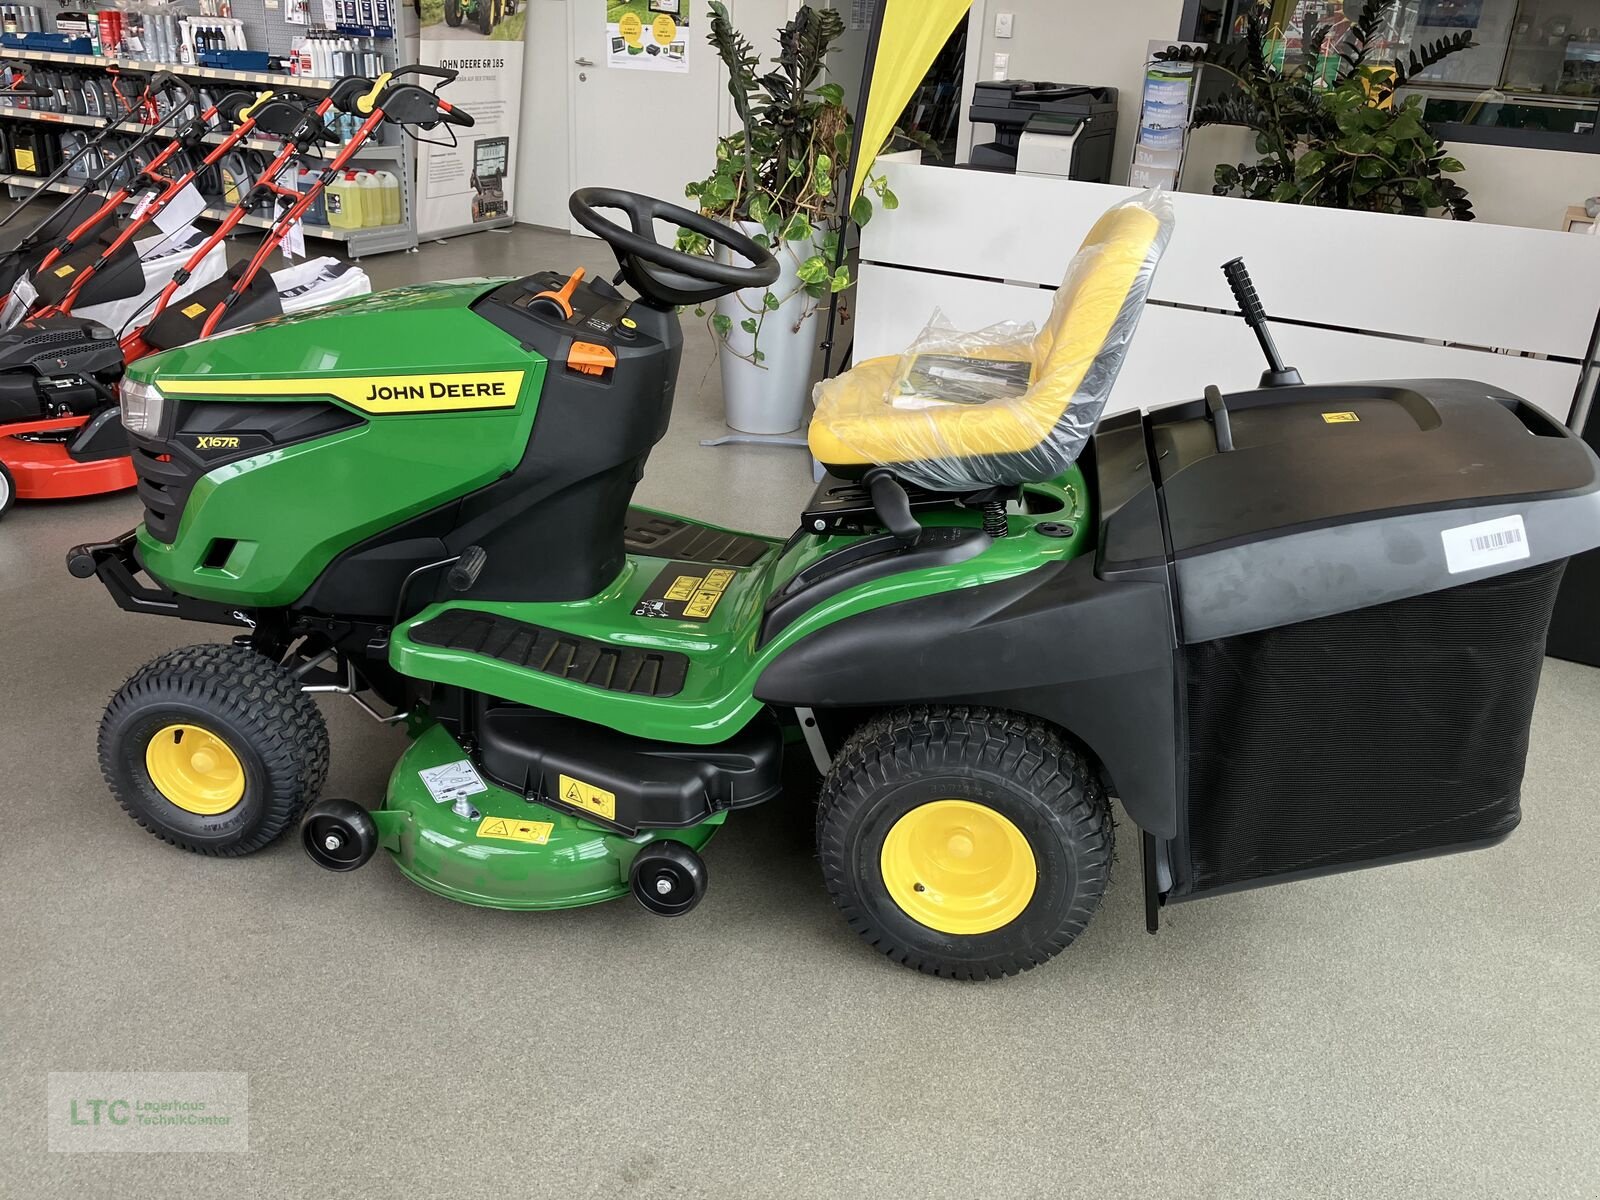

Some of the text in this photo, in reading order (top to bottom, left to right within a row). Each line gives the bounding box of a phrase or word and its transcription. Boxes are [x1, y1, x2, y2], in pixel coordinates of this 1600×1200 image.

[440, 58, 504, 69] JOHN DEERE 6R 185
[196, 436, 239, 449] X167R
